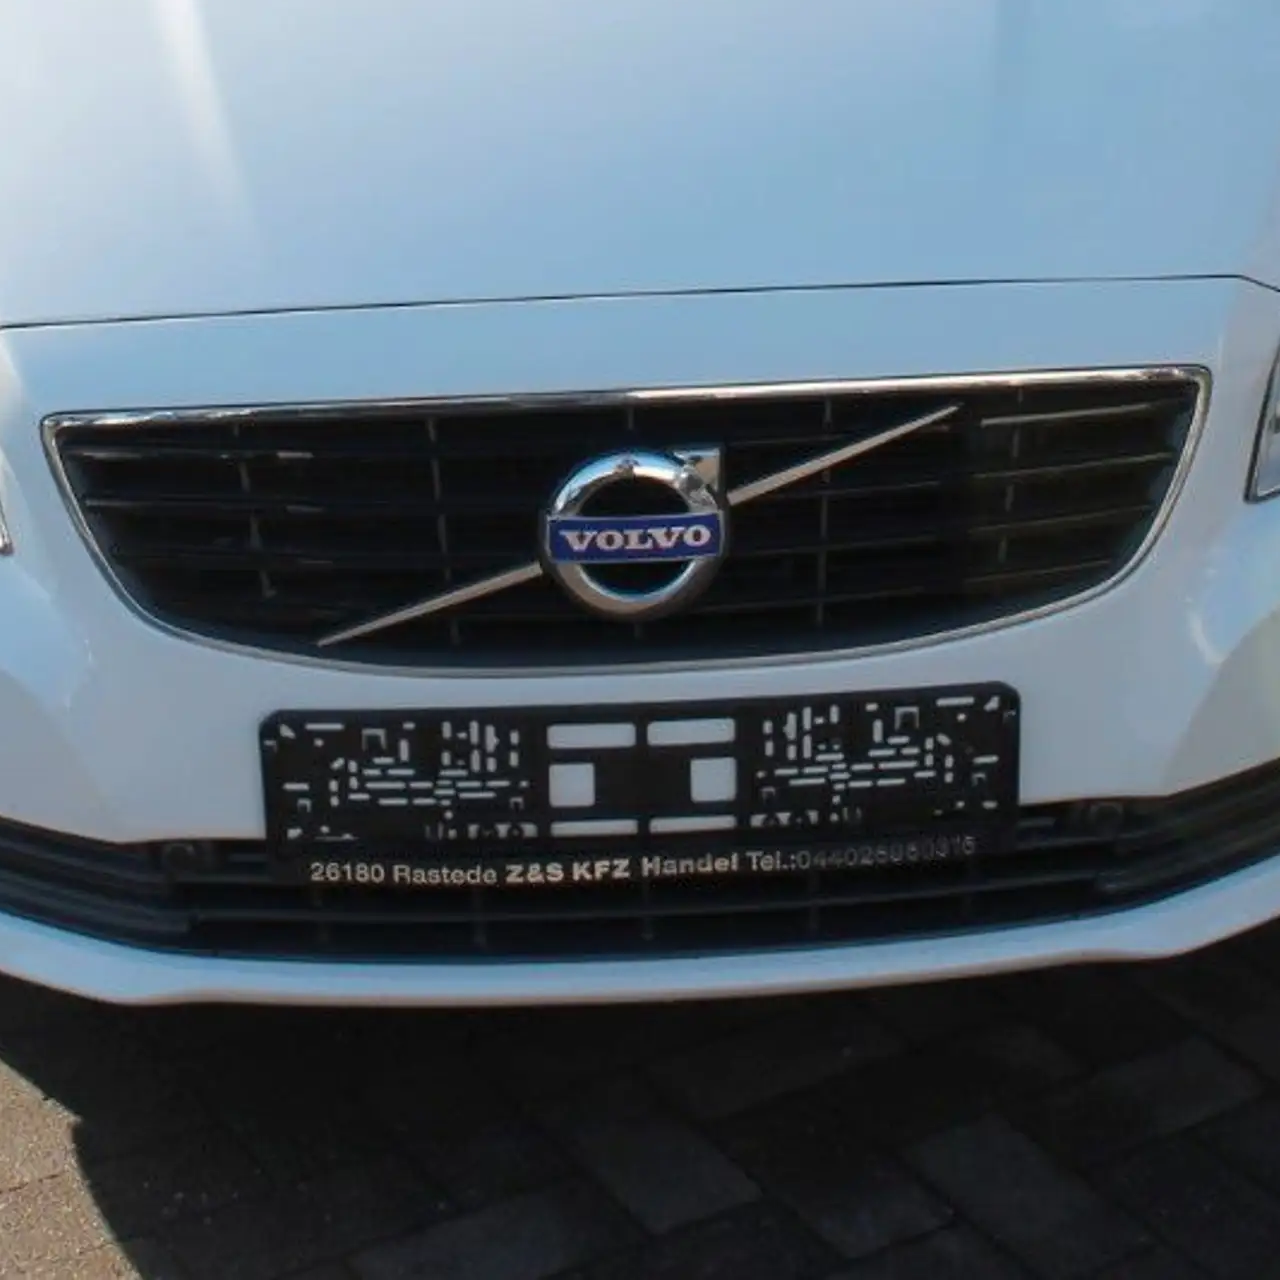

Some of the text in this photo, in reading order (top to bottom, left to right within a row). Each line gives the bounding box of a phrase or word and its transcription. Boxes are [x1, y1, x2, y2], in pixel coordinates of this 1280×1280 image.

[559, 523, 712, 553] VOLVO
[310, 861, 386, 884] 26180
[393, 863, 499, 886] Rastede
[505, 861, 564, 883] Z&S
[572, 858, 631, 883] KFZ
[641, 851, 739, 878] Handel
